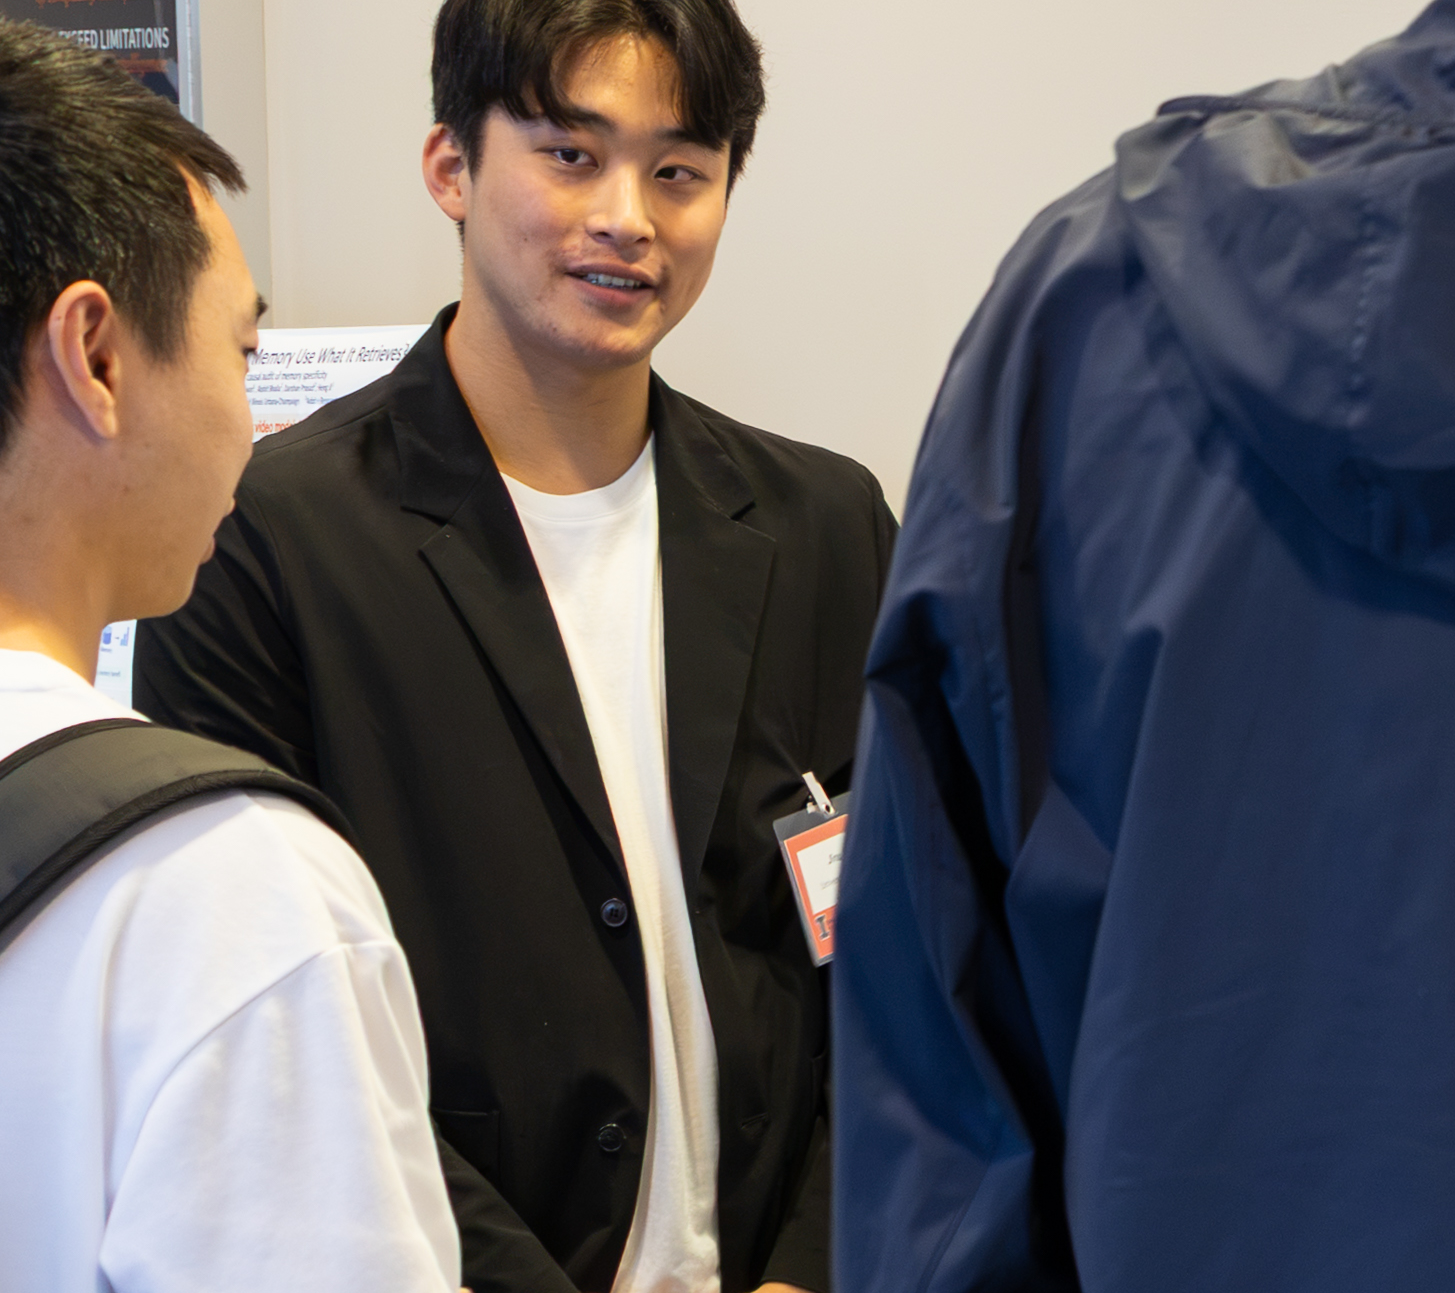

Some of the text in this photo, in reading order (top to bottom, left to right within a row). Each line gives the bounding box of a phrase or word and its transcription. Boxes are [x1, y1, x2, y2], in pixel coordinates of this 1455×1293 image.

[100, 27, 170, 50] LIMITATIONS
[251, 343, 410, 369] Memory Use What It Retrieves?
